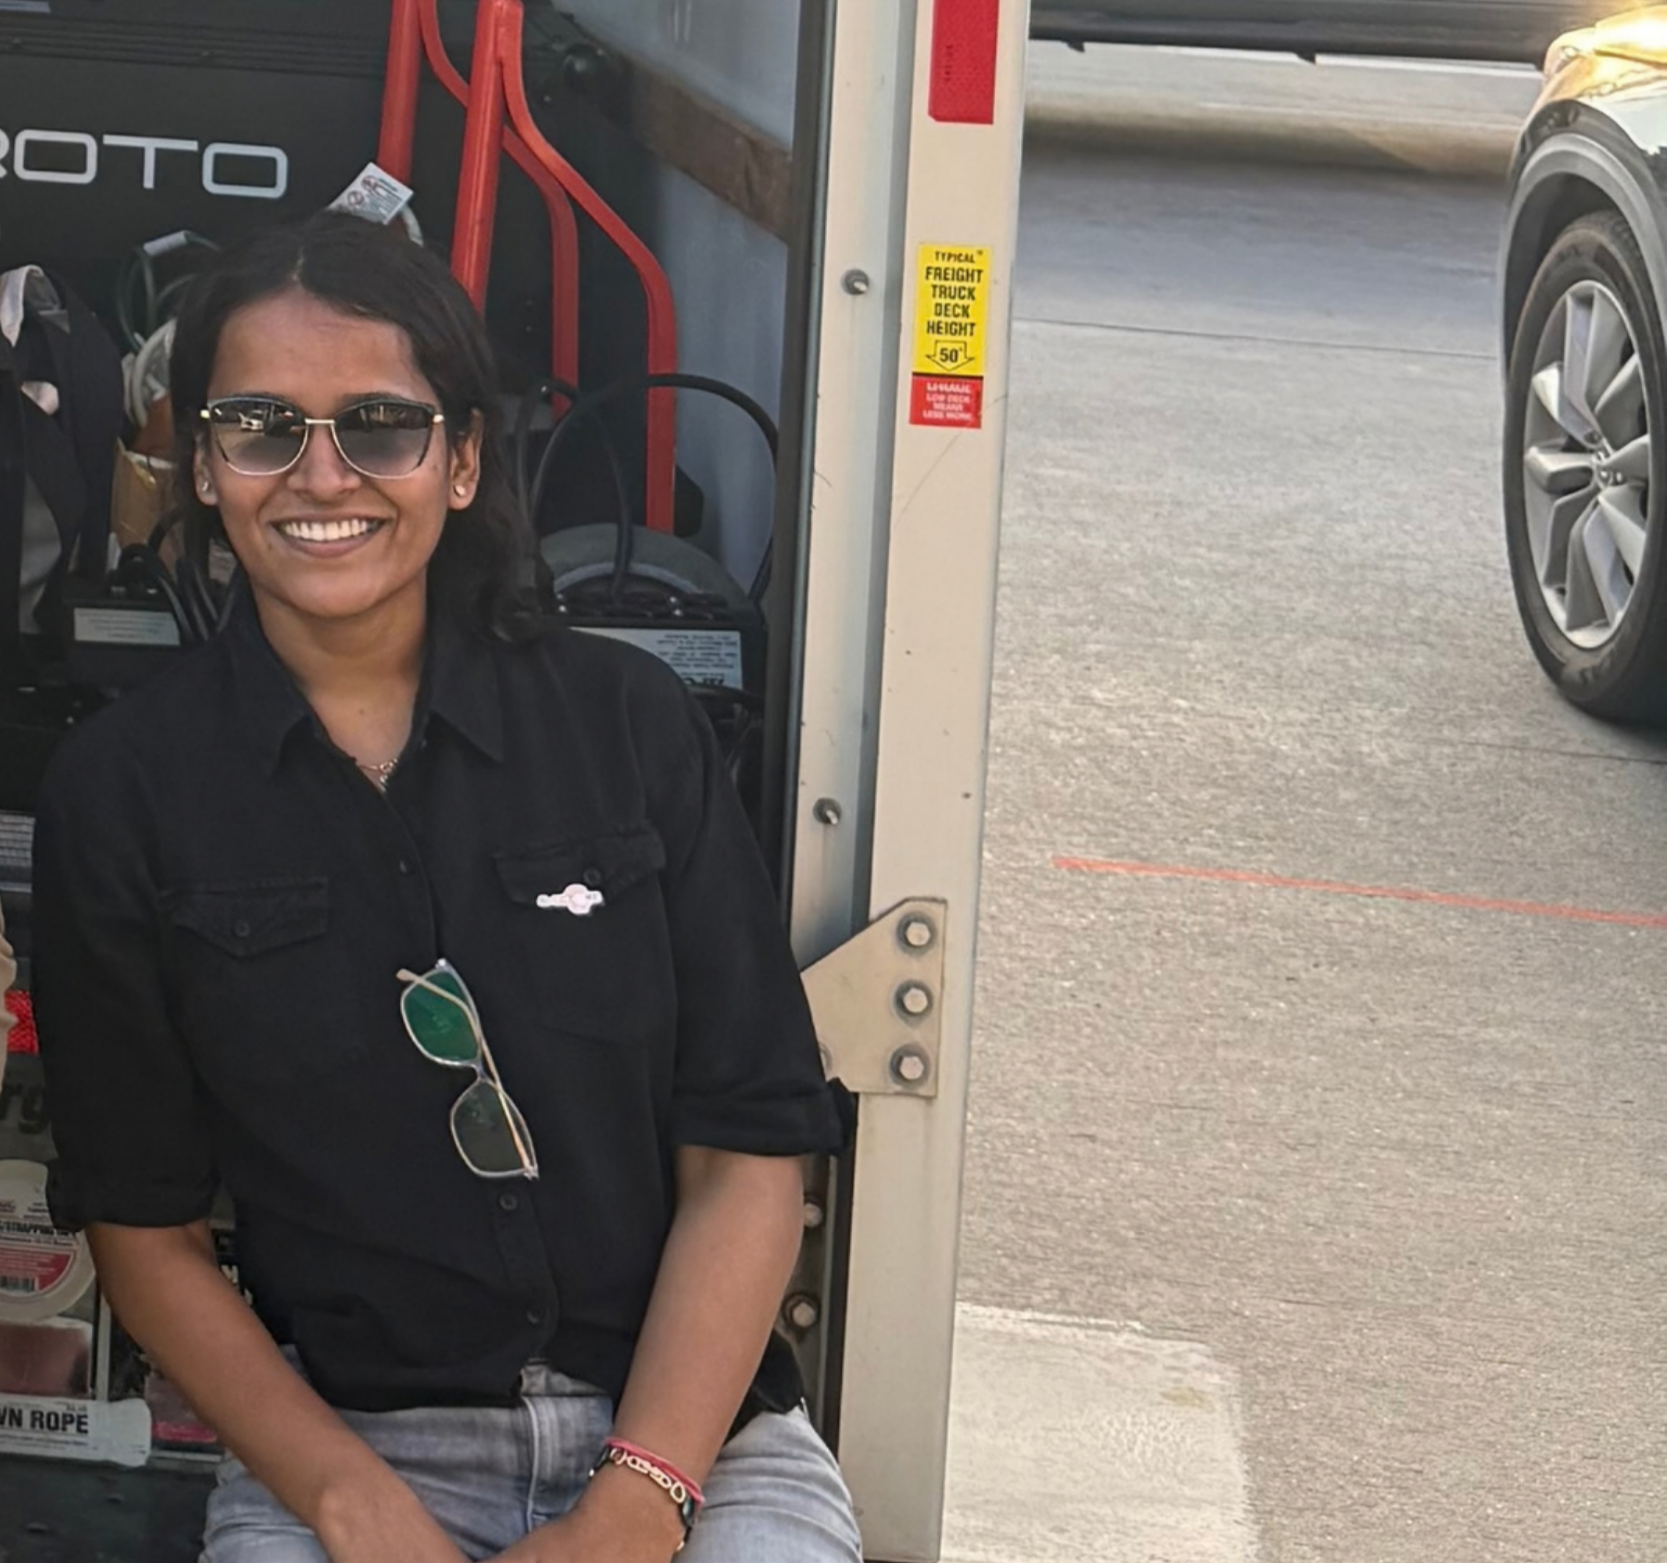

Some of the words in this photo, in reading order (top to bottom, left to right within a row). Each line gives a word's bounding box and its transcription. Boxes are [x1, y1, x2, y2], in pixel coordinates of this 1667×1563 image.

[935, 251, 975, 264] TYPICAL
[925, 266, 983, 283] FREIGHT
[931, 284, 976, 301] TRUCK
[934, 303, 970, 318] DECK
[926, 321, 976, 337] HEIGHT
[30, 1409, 89, 1434] ROPE
